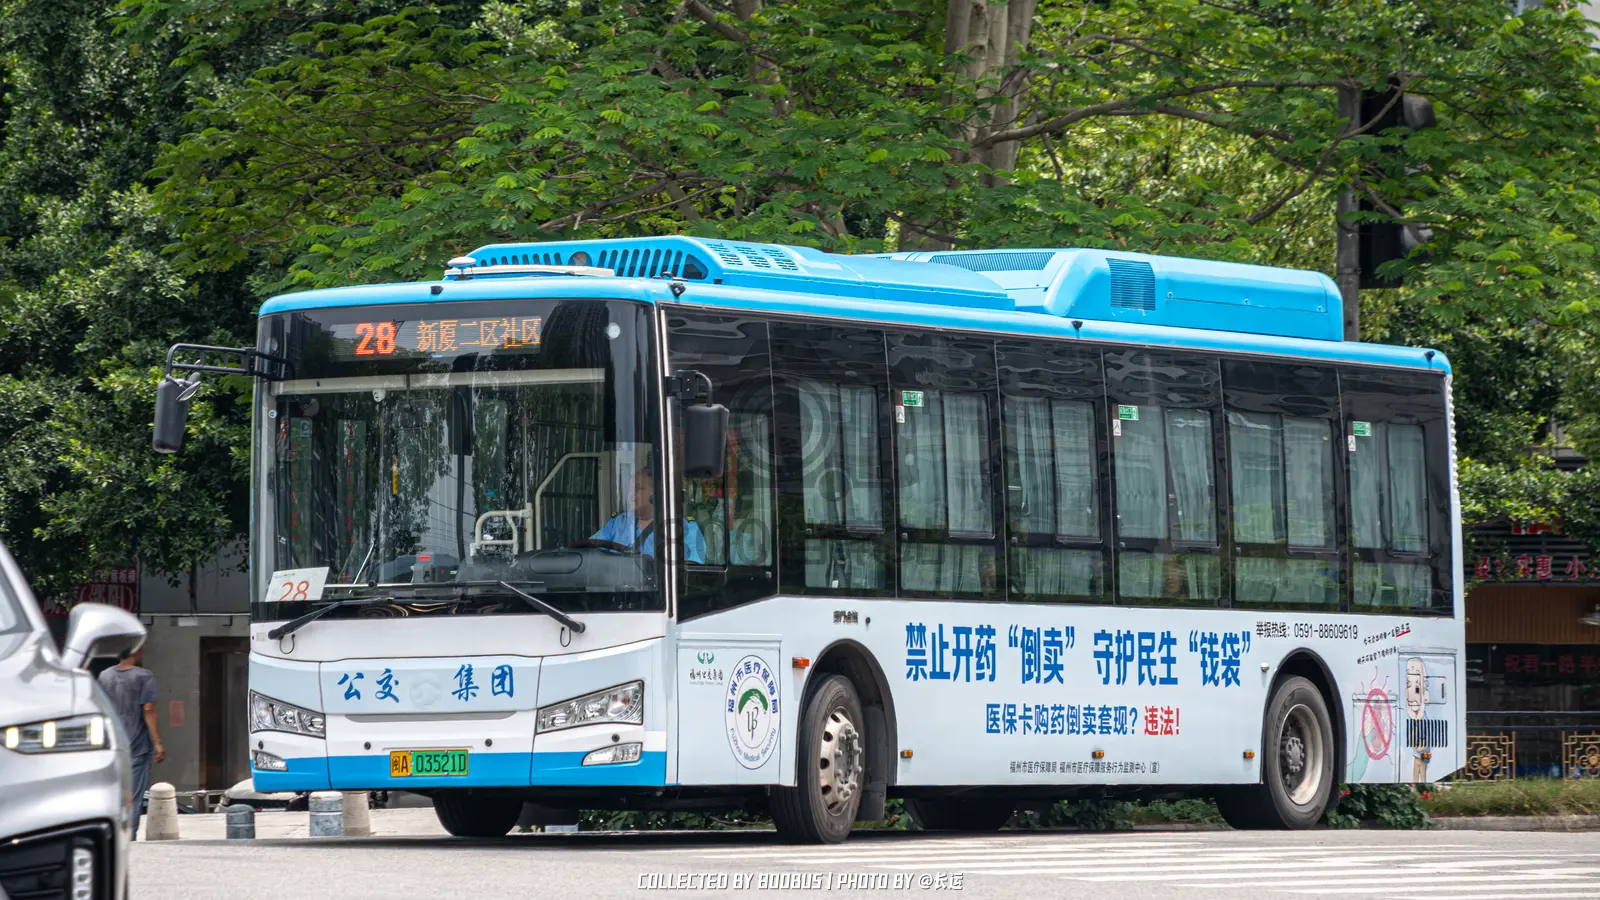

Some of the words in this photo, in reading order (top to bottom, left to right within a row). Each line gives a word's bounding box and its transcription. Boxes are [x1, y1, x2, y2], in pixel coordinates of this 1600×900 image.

[355, 321, 397, 356] 28
[416, 317, 542, 353] 新厦二区社区
[1474, 555, 1552, 579] 经实惠
[279, 579, 311, 602] 28
[1504, 653, 1600, 674] 祝君一路平
[1010, 761, 1057, 774] 福州市医疗保障局
